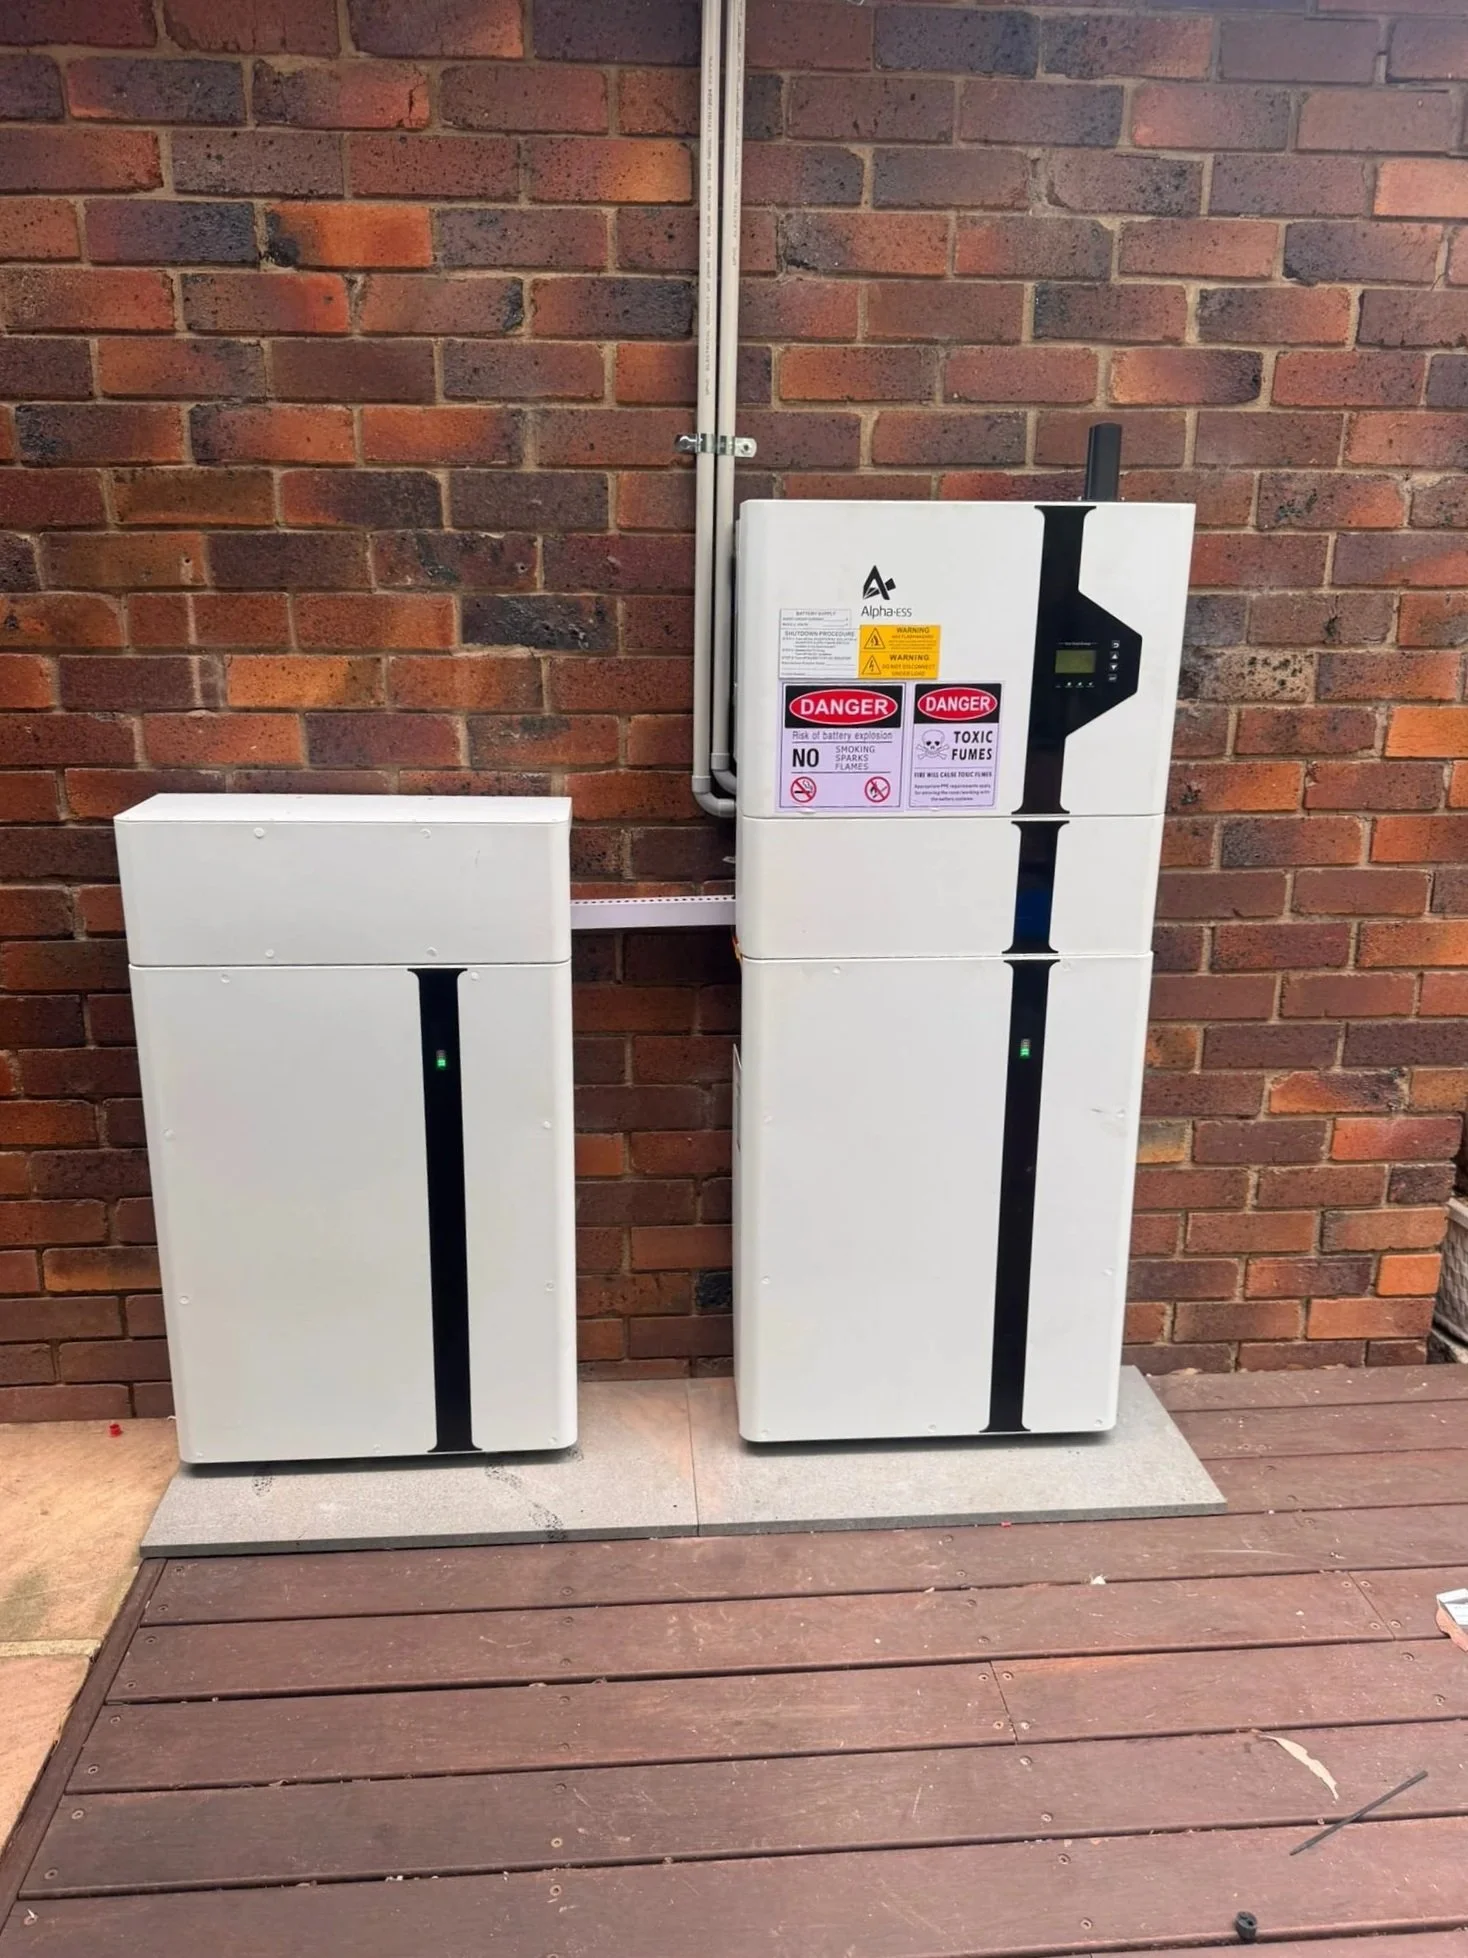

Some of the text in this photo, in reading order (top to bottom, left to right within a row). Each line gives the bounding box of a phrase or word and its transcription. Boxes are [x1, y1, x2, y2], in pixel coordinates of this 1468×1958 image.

[800, 699, 889, 715] DANGER
[925, 696, 991, 712] DANGER
[792, 730, 893, 741] Risk of battery explosion
[953, 730, 993, 743] TOXIC
[835, 745, 875, 753] SMOKING
[951, 748, 993, 760] FUMES
[792, 748, 819, 768] NO
[835, 754, 869, 762] SPARKS
[835, 762, 869, 770] FLAMES
